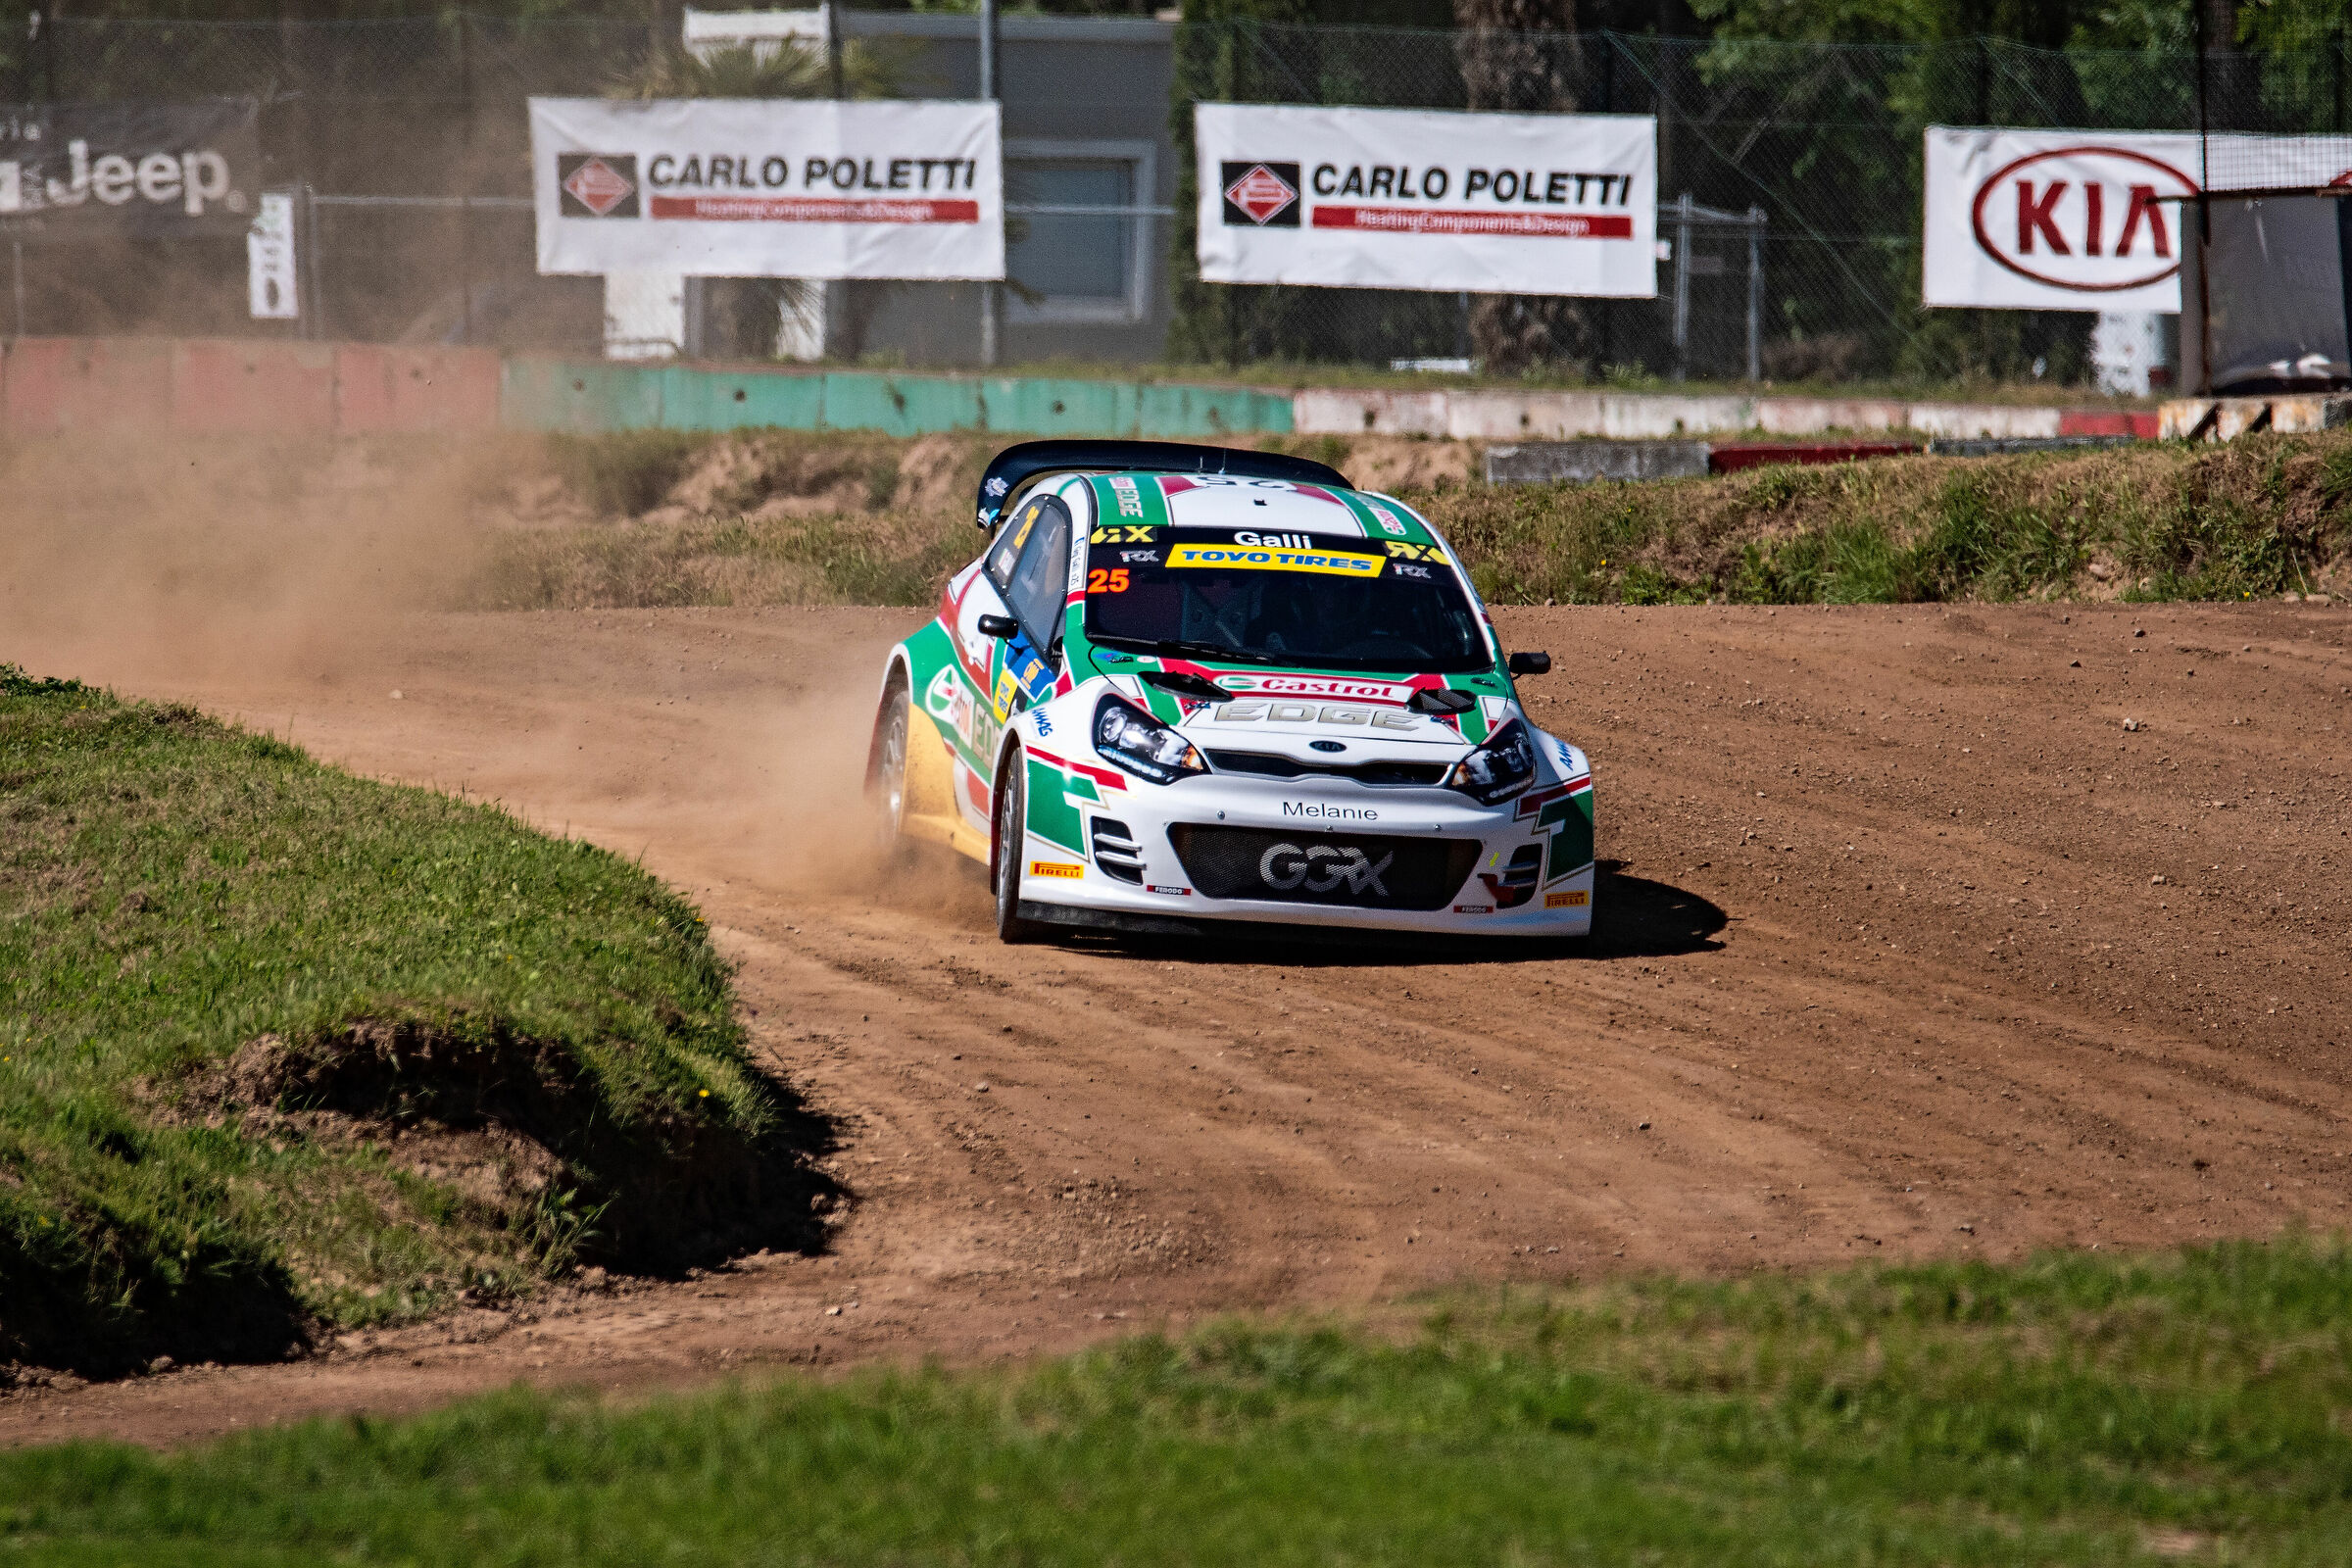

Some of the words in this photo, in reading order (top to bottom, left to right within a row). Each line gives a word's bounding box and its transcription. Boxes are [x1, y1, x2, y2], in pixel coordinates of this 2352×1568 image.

[47, 139, 231, 216] Jeep
[648, 154, 789, 189] CARLO
[804, 157, 976, 190] POLETTI
[1313, 164, 1449, 199] CARLO
[1464, 169, 1633, 207] POLETTI
[2016, 179, 2171, 259] KIA
[1233, 530, 1312, 550] Galli
[1181, 550, 1271, 564] TOYO
[1276, 553, 1373, 571] TIRES
[1087, 567, 1131, 594] 25
[1261, 676, 1396, 700] Castrol
[1214, 702, 1424, 732] EDGE
[1283, 802, 1379, 822] Melanie
[1034, 862, 1081, 878] PIRELLI
[1547, 891, 1585, 907] PIRELLI
